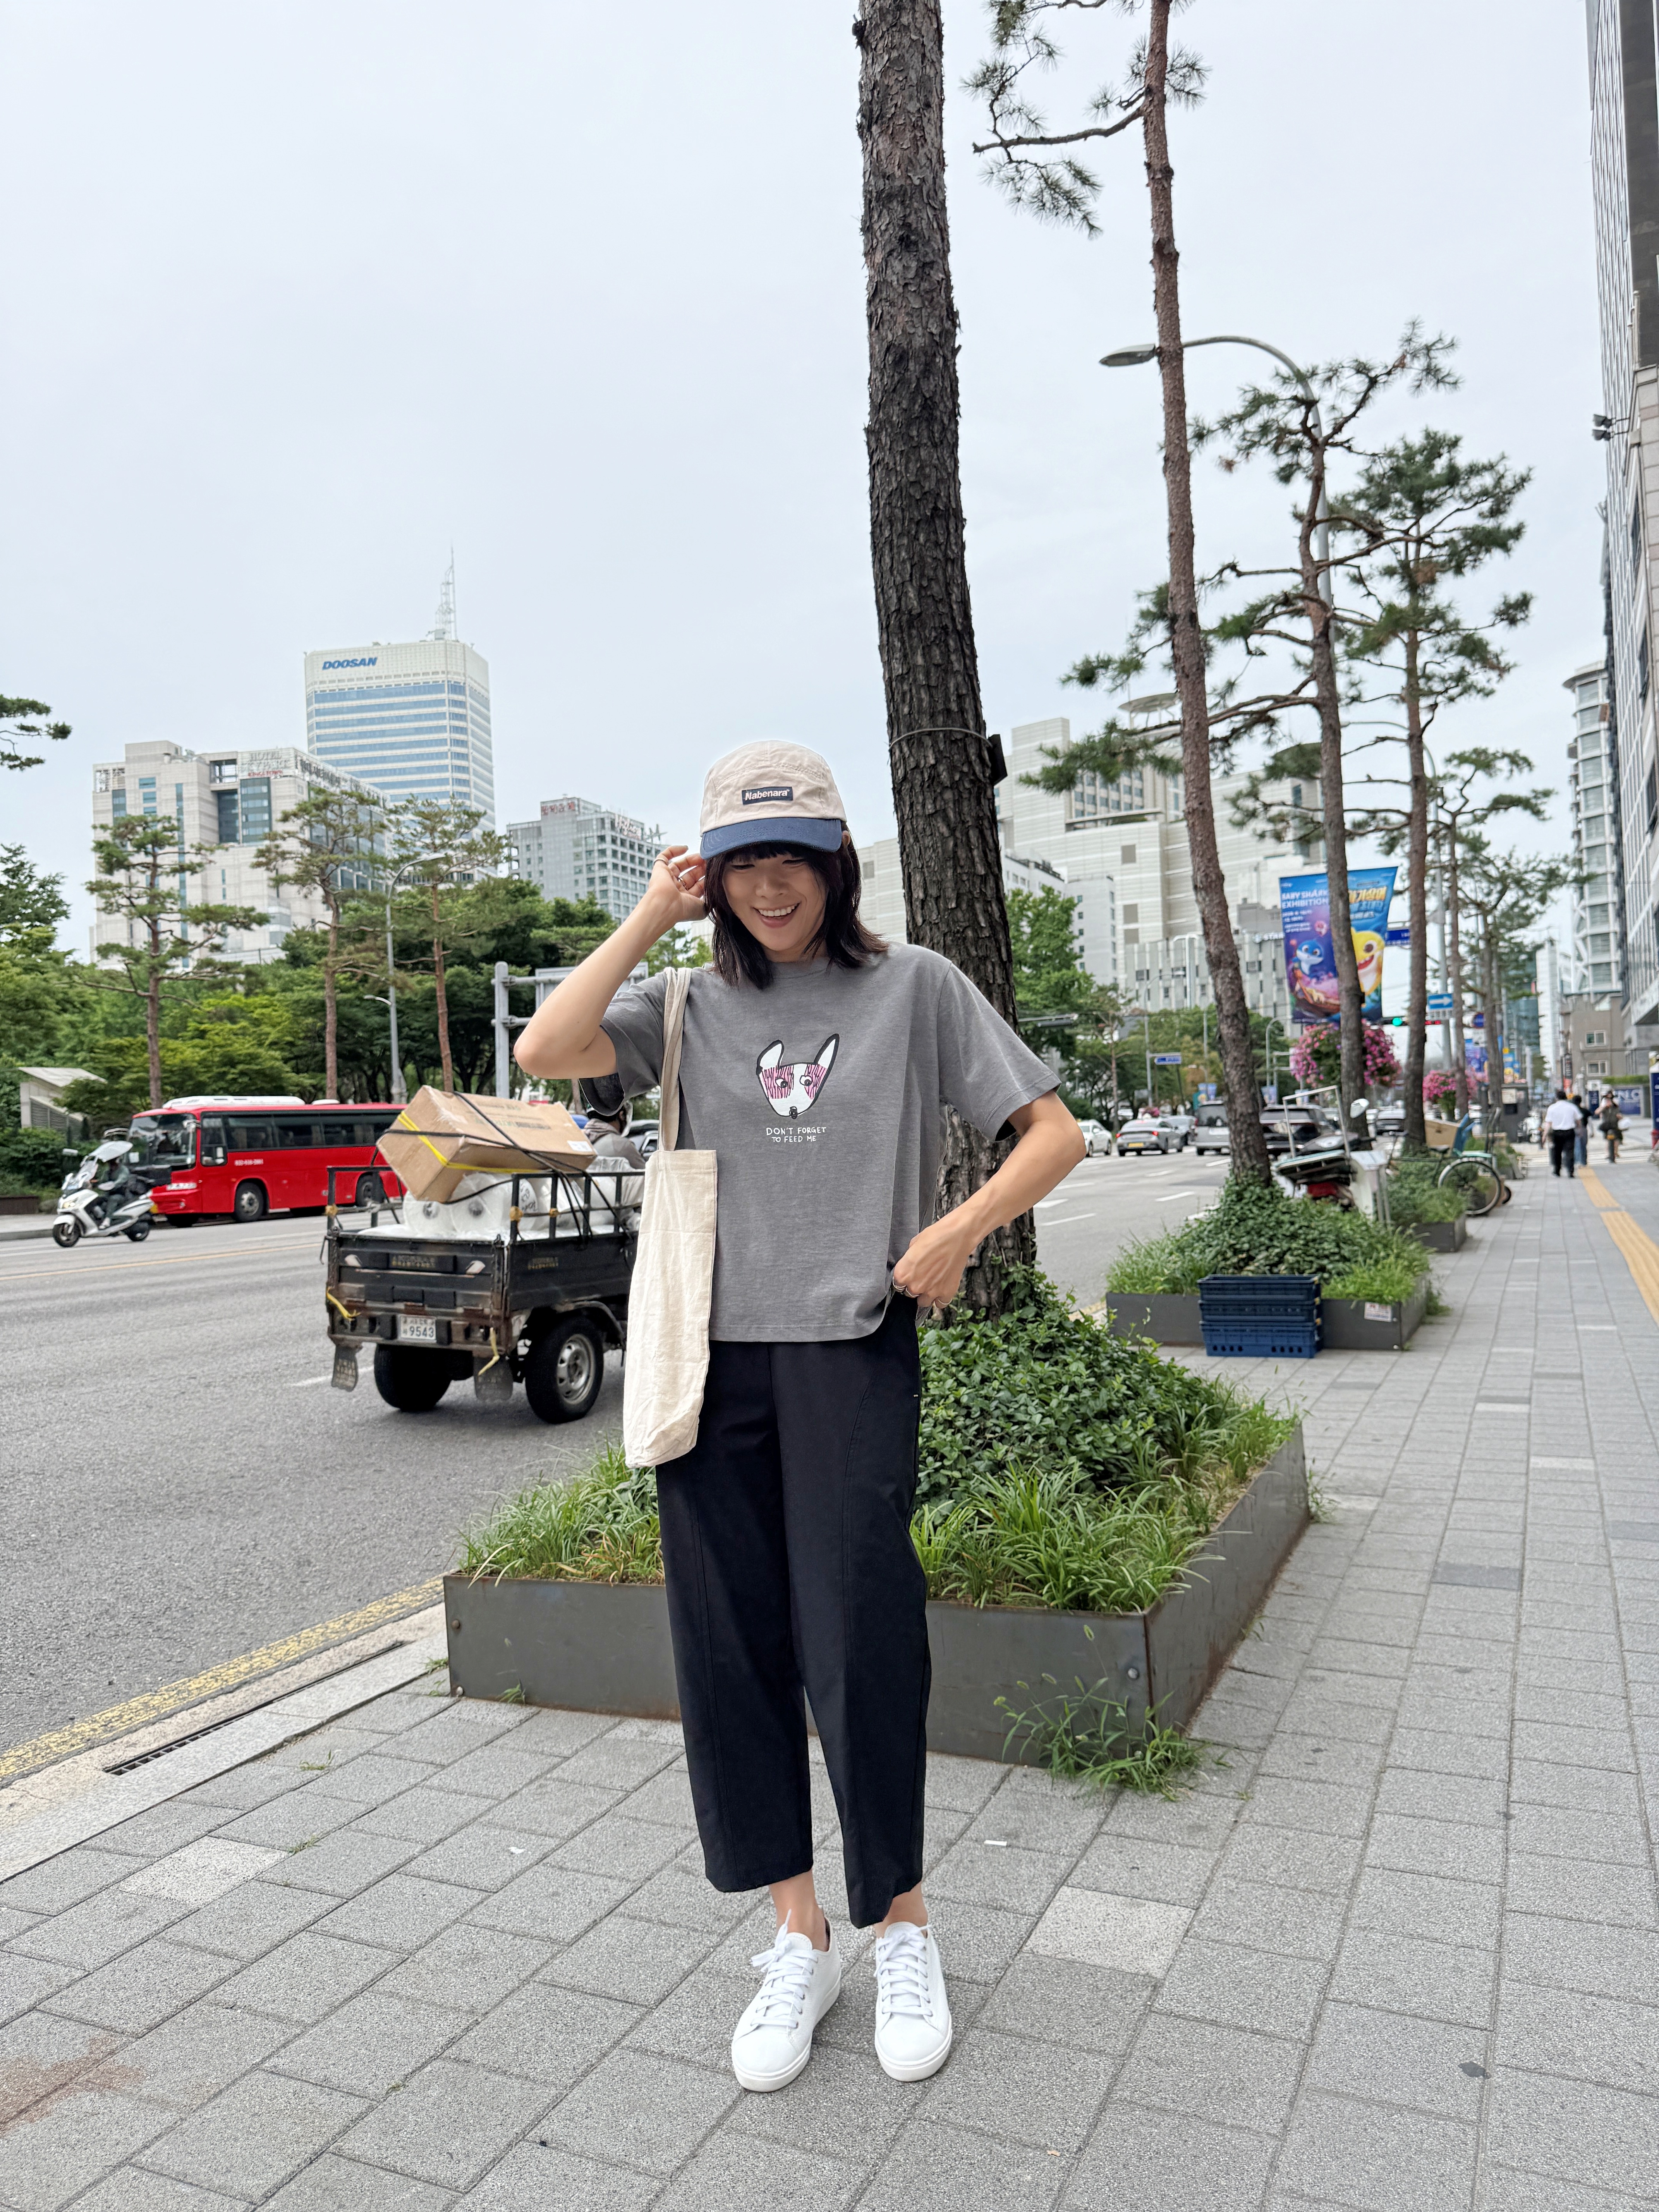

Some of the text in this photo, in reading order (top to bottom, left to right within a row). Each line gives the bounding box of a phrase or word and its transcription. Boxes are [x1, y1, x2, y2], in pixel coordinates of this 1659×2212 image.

[322, 657, 378, 670] DOOSAN
[1281, 892, 1300, 901] BABY
[1281, 898, 1329, 909] EXHIBITION
[766, 1127, 793, 1135] DON'T
[410, 1326, 434, 1338] 9543
